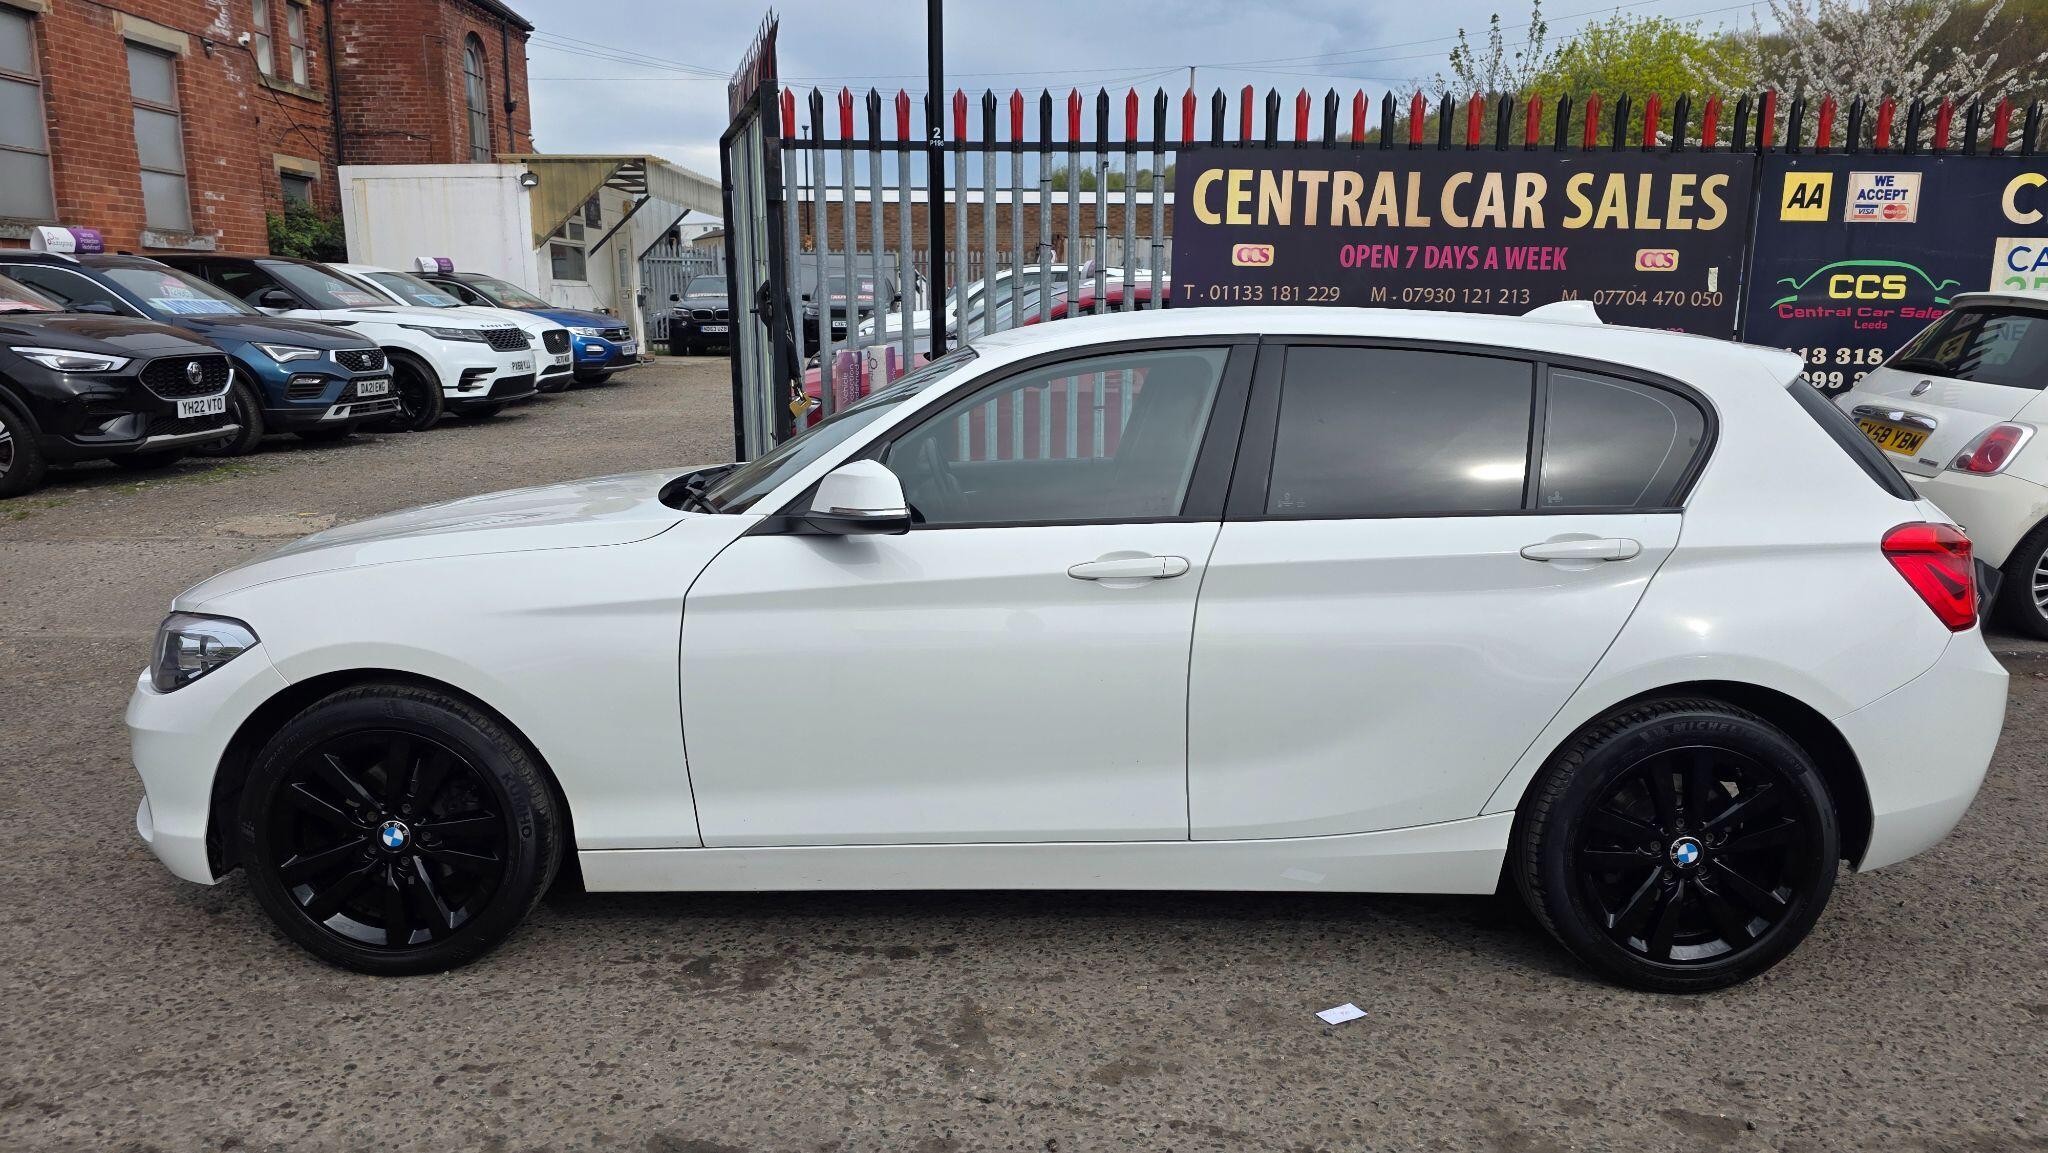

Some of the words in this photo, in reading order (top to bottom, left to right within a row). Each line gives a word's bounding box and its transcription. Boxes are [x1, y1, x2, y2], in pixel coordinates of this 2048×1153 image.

[932, 126, 941, 139] 2
[1874, 175, 1895, 187] WE
[1192, 168, 1431, 227] CENTRAL
[1440, 171, 1548, 229] CAR
[1562, 172, 1730, 231] SALES
[1786, 182, 1825, 209] AA
[1856, 188, 1909, 201] ACCEPT
[1236, 247, 1270, 263] CCS
[1339, 244, 1399, 269] OPEN
[1405, 245, 1419, 269] 7
[1424, 245, 1479, 270] DAYS
[1483, 246, 1499, 270] A
[1505, 246, 1569, 271] WEEK
[1639, 251, 1675, 268] CCS
[1209, 284, 1264, 301] 01133
[1271, 285, 1300, 301] 181
[1307, 286, 1341, 302] 229
[1402, 286, 1456, 304] 07930
[1462, 288, 1491, 304] 121
[1499, 288, 1531, 304] 213
[1828, 274, 1907, 300] CCS
[1593, 289, 1647, 307] 07704
[1652, 290, 1685, 307] 470
[1690, 290, 1723, 307] 050
[1778, 303, 1851, 319] Central
[1857, 307, 1895, 318] Car
[1854, 320, 1888, 330] Leeds
[1786, 347, 1827, 365] 13
[1835, 347, 1883, 366] 318
[841, 372, 849, 404] Vehicle
[182, 399, 206, 415] YH22
[206, 397, 223, 412] VTO
[1890, 430, 1923, 452] YBM
